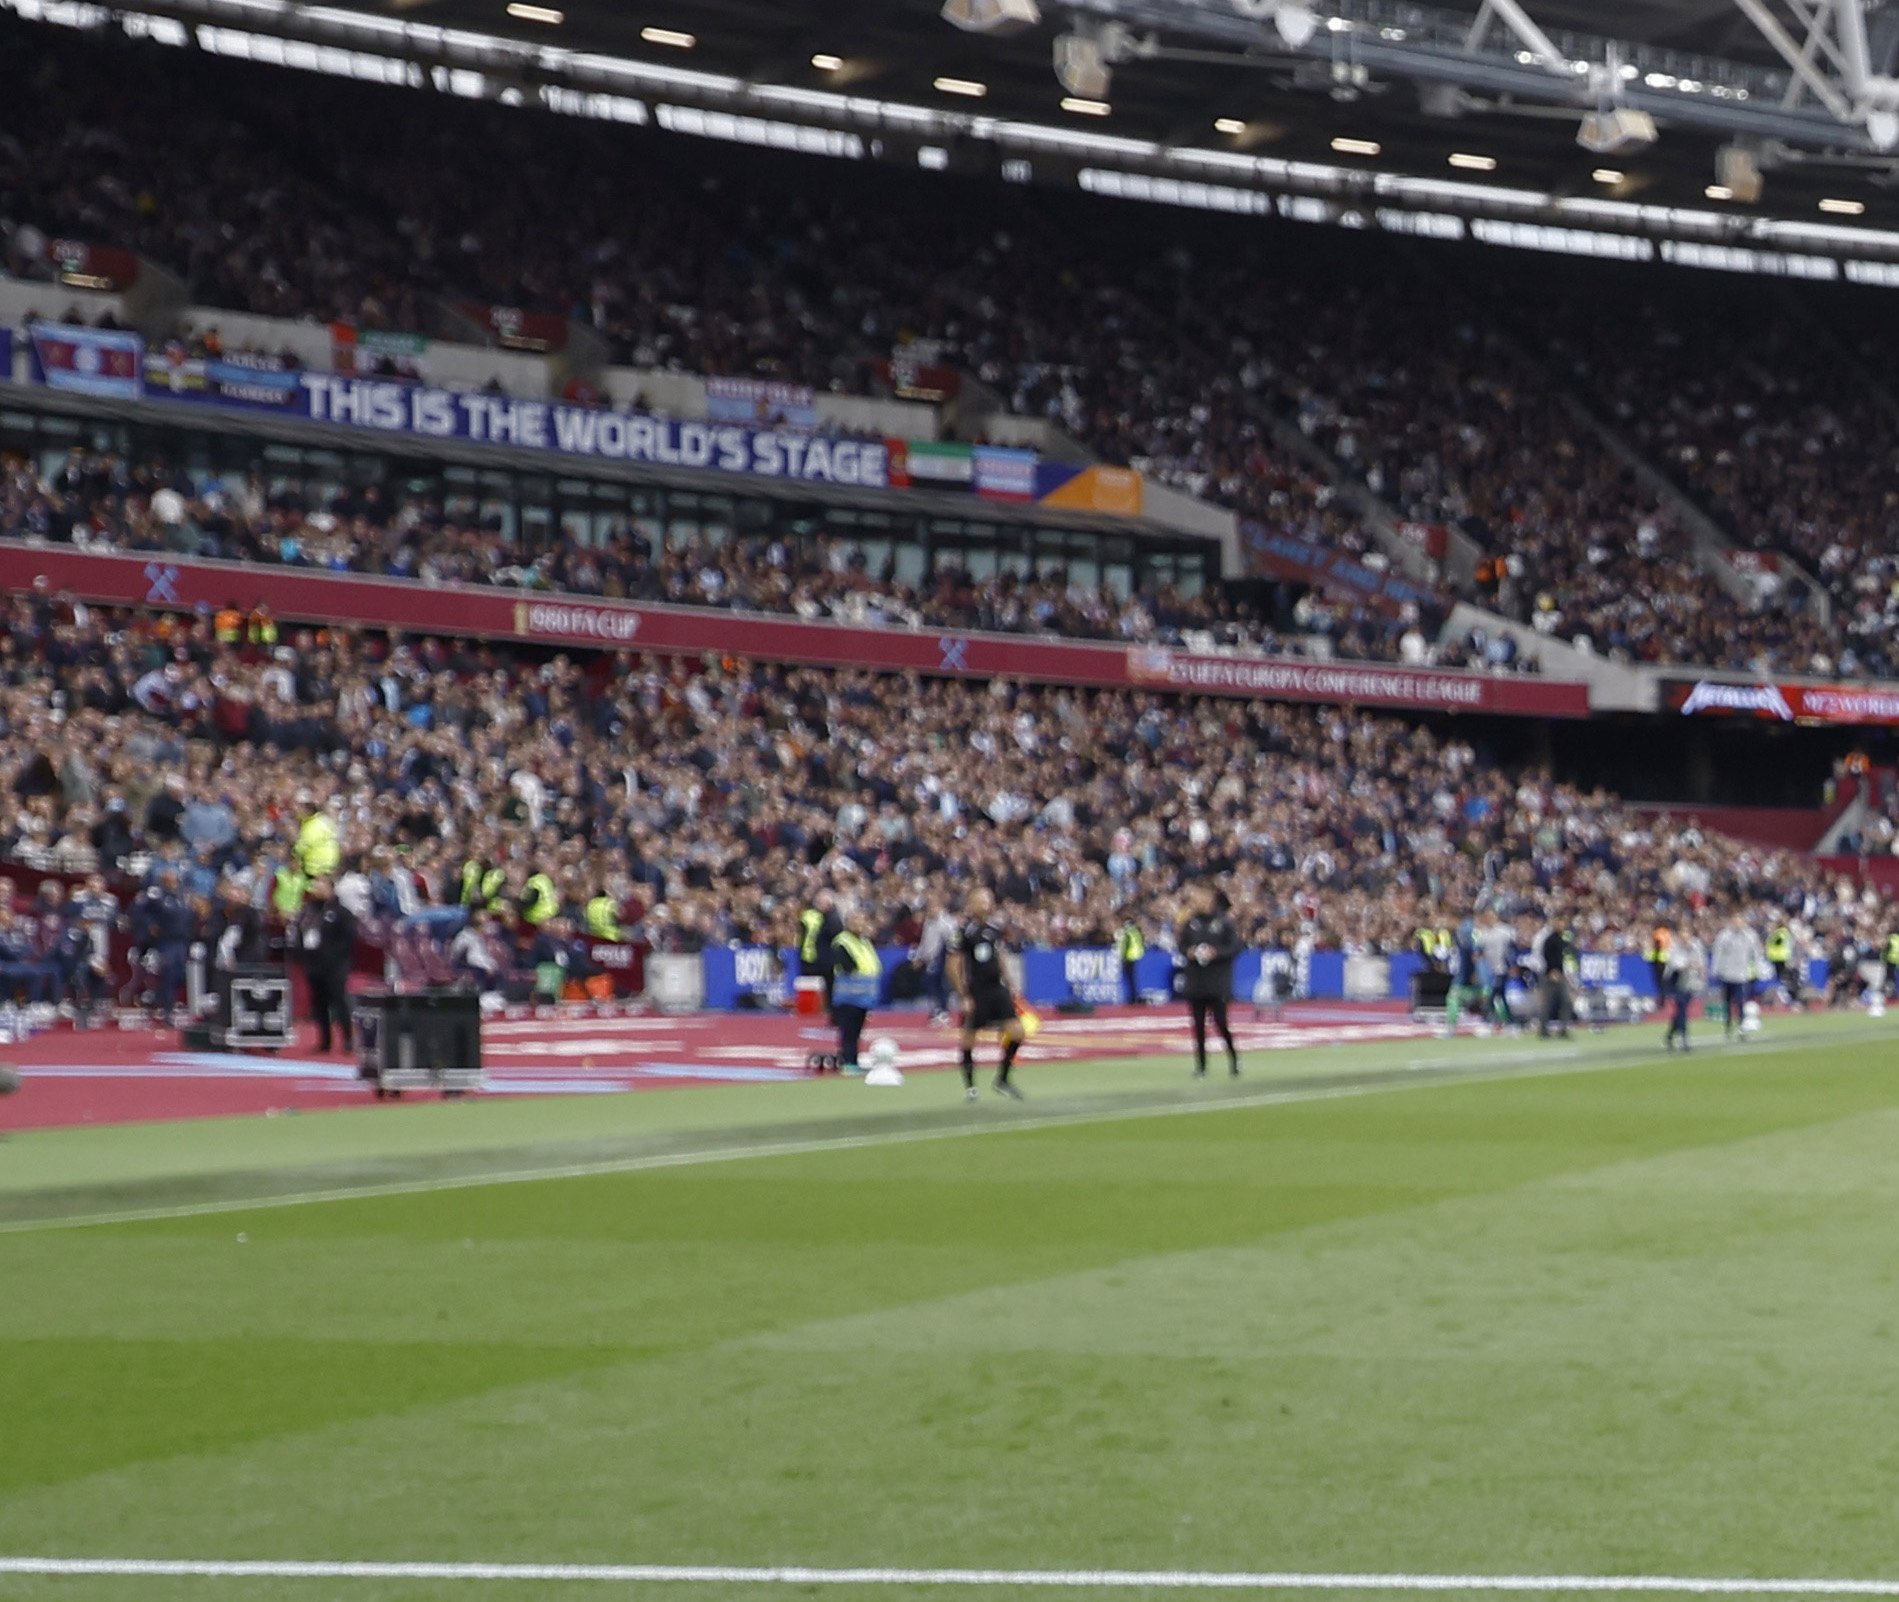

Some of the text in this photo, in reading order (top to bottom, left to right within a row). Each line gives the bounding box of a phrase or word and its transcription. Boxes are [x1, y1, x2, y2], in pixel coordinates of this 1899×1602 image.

[300, 371, 888, 487] THIS IS THE WORLD'S STAGE
[598, 609, 641, 641] CUP
[1065, 950, 1122, 981] BOYLE
